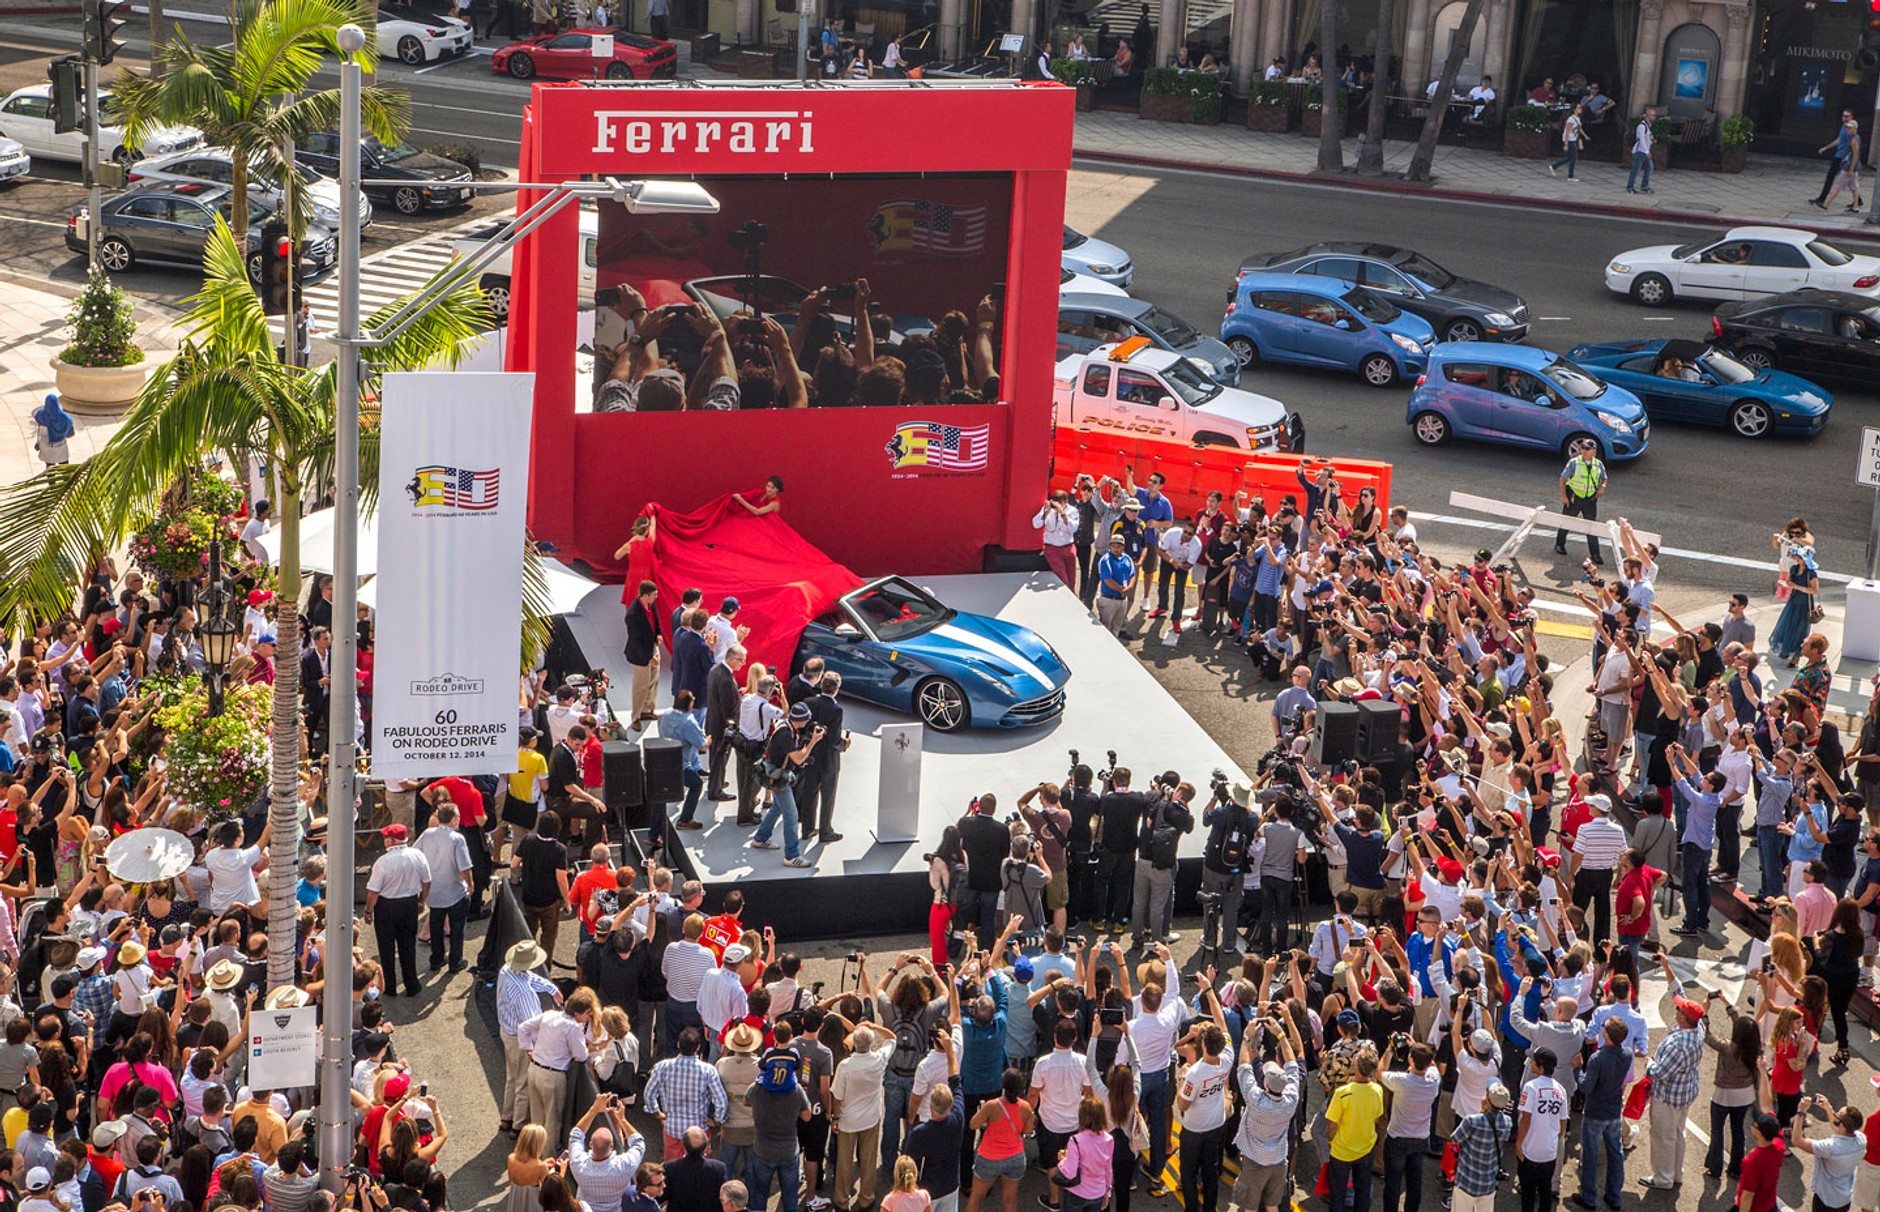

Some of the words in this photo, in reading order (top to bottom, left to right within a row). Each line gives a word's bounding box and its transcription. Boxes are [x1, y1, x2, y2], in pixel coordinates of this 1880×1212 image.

[1786, 45, 1851, 61] MIKIMOTO
[591, 110, 814, 153] Ferrari
[1082, 415, 1166, 435] POLICE
[416, 684, 448, 692] RODEO
[451, 683, 478, 691] DRIVE
[434, 709, 457, 725] 60
[383, 726, 448, 737] FABULOUS
[450, 723, 507, 736] FERRARIS
[392, 738, 412, 749] ON
[414, 737, 458, 748] RODEO
[461, 735, 498, 747] DRIVE
[404, 752, 447, 760] OCTOBER
[464, 750, 486, 759] 2014
[773, 1067, 787, 1085] 10
